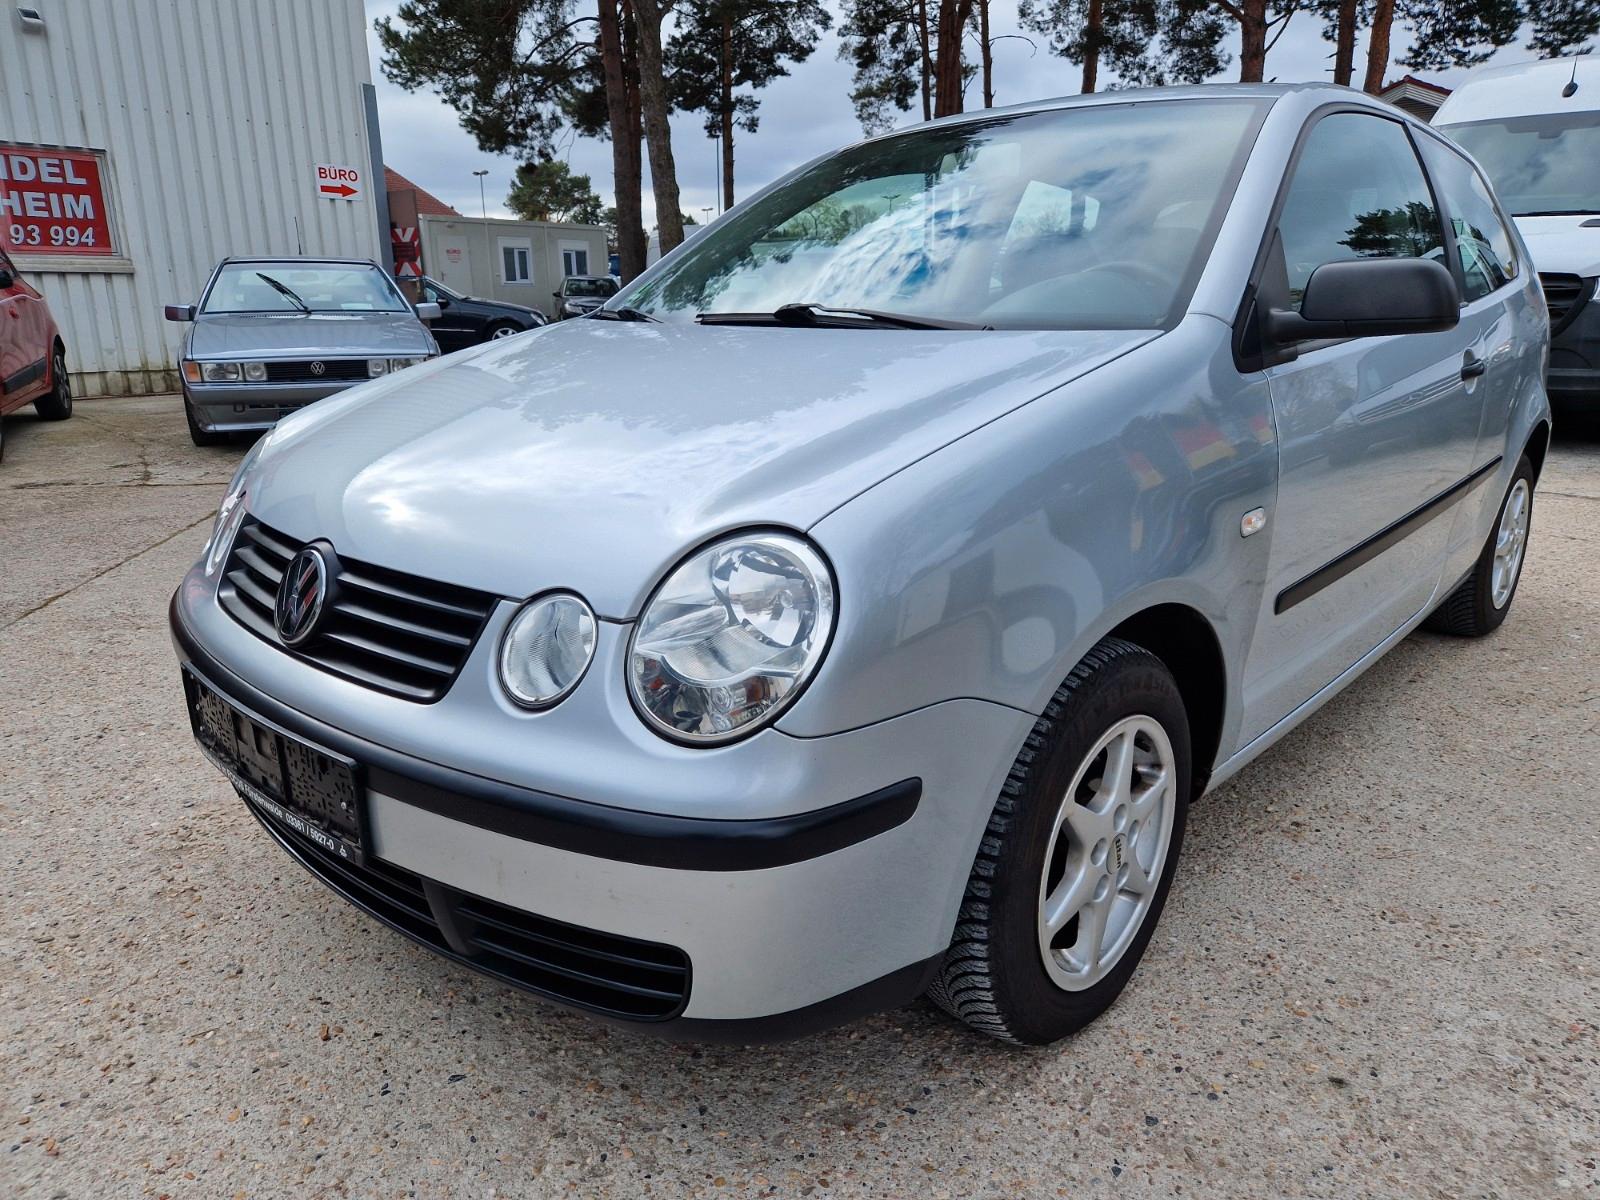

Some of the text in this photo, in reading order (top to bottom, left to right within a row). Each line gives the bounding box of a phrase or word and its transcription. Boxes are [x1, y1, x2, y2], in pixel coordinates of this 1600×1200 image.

[318, 166, 358, 182] BÜRO
[10, 224, 95, 246] 93 994
